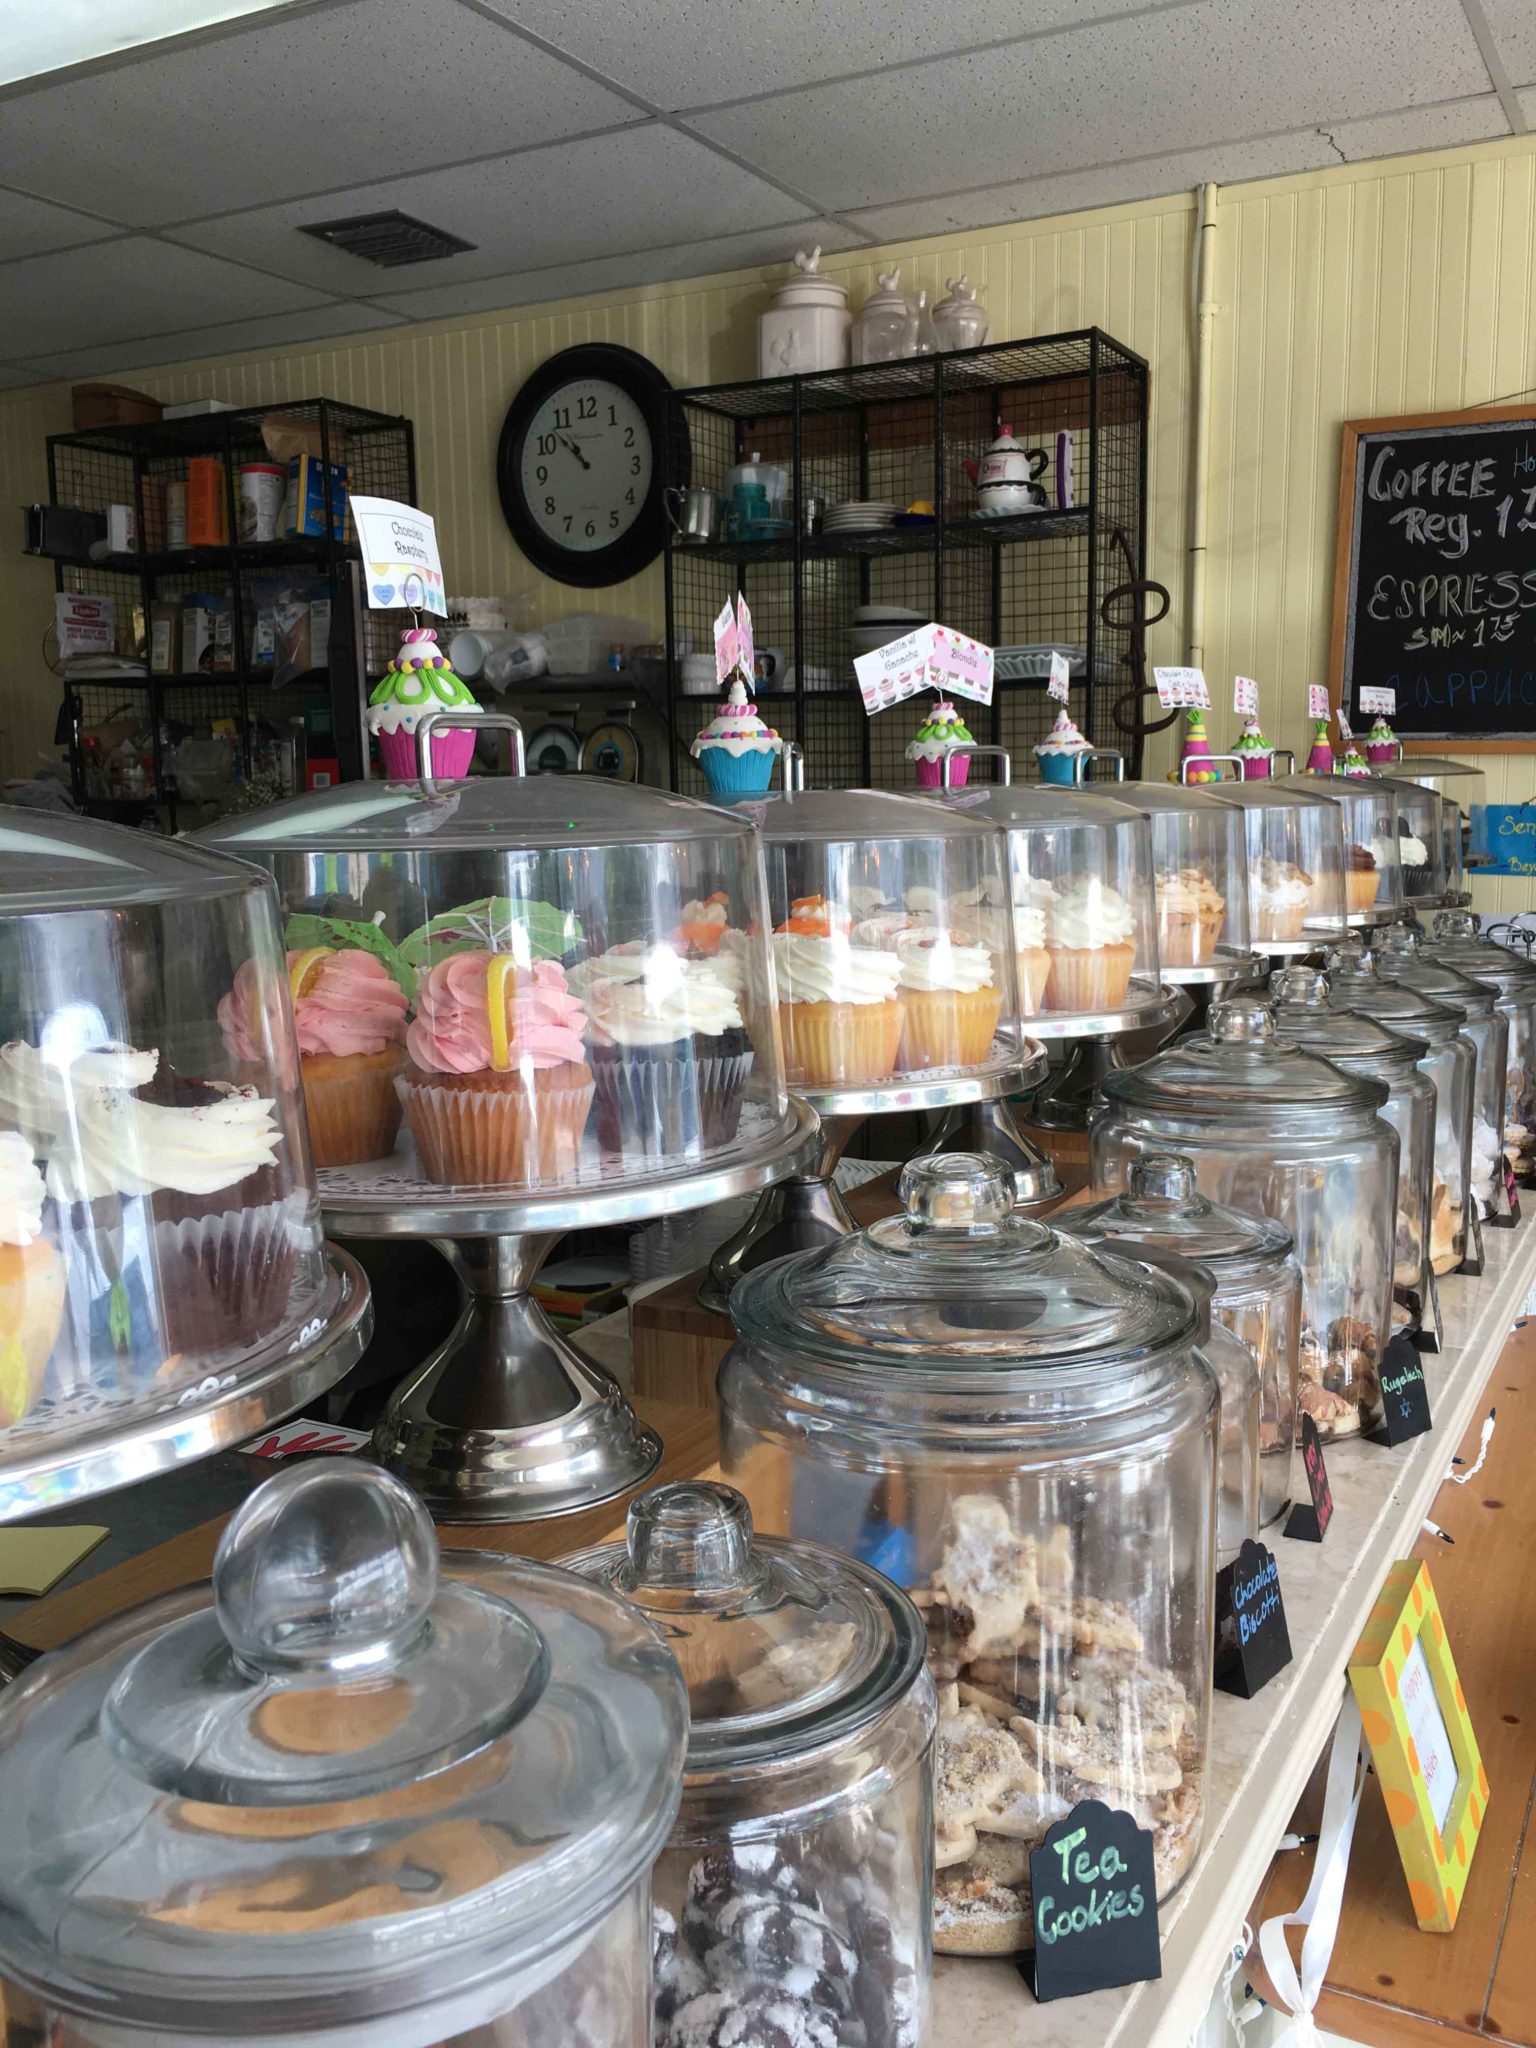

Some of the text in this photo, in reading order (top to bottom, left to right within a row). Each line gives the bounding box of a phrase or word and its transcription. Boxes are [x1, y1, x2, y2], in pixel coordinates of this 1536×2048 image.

[553, 407, 572, 430] 11
[576, 396, 598, 420] 12
[608, 404, 618, 427] 1
[536, 433, 557, 457] 10
[623, 426, 635, 449] 2
[536, 465, 548, 486] 9
[630, 455, 642, 476] 3
[1367, 446, 1498, 502] COFFEE
[544, 496, 556, 515] 8
[625, 487, 636, 506] 4
[563, 515, 574, 534] 7
[584, 519, 596, 538] 6
[608, 509, 620, 529] 5
[1388, 506, 1482, 559] Reg.
[878, 639, 907, 659] Vanilla
[884, 650, 919, 671] Ganache
[951, 647, 978, 668] Blondie
[1381, 1364, 1424, 1396] Rugelach
[1234, 1556, 1280, 1610] Chocolate
[1239, 1585, 1280, 1646] Biscotti
[1053, 1826, 1128, 1885] Tea
[1037, 1883, 1145, 1945] Cookies
